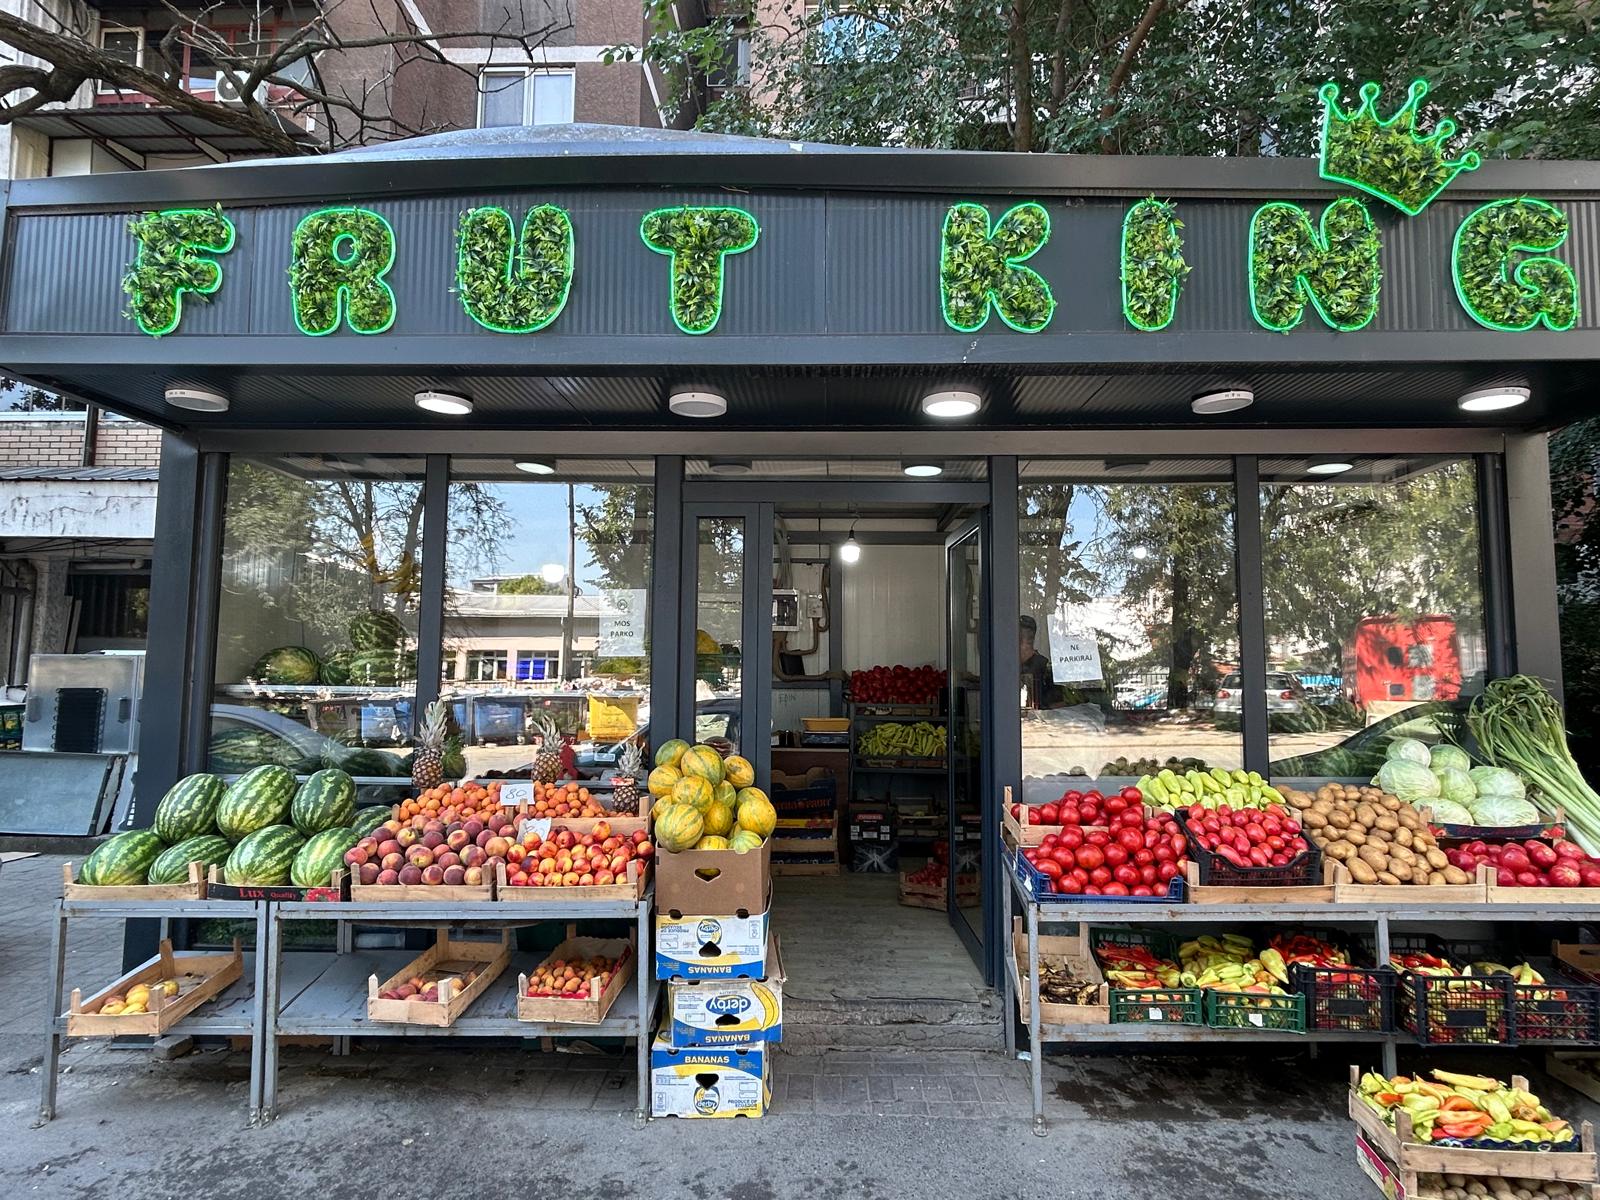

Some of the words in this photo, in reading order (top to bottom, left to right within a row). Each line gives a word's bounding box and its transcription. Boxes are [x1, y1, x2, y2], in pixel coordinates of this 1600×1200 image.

[122, 203, 762, 336] FRUT
[940, 196, 1579, 332] KING
[610, 630, 634, 638] PARKO
[1059, 654, 1093, 663] PARKIRAJ
[505, 788, 527, 800] 80
[688, 966, 732, 974] BANANAS
[709, 997, 748, 1014] derby
[705, 1034, 750, 1043] BANANAS
[684, 1056, 730, 1064] BANANAS
